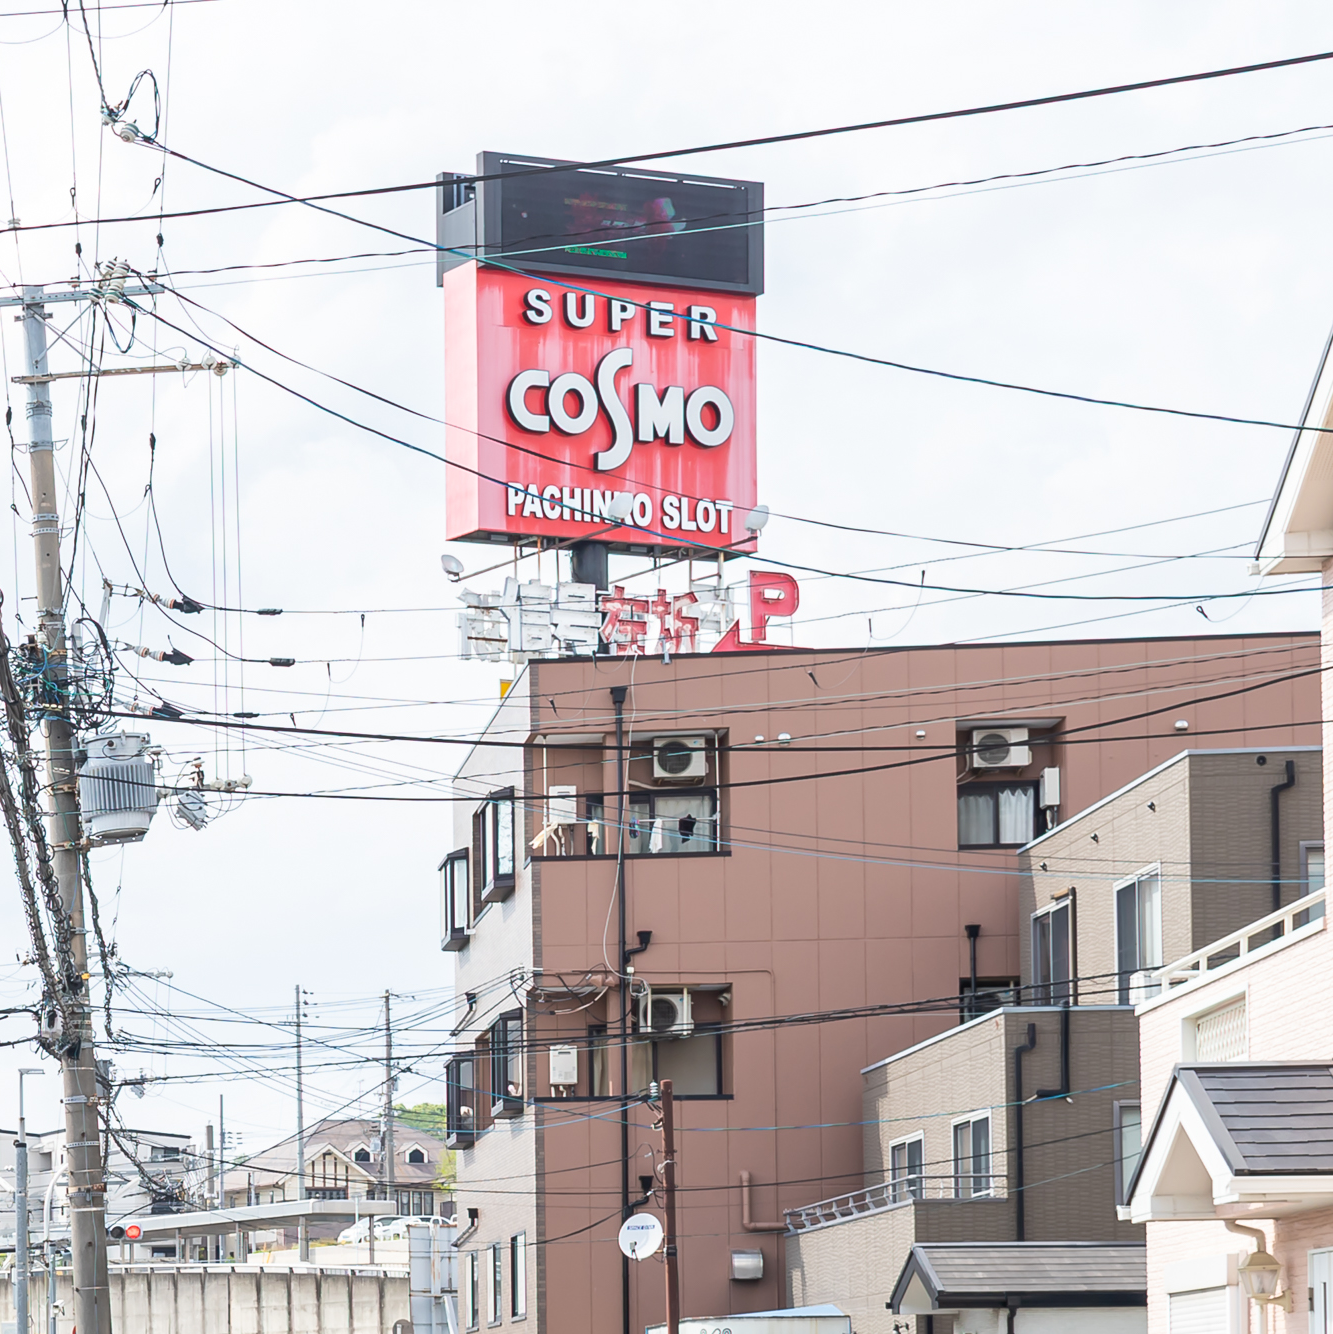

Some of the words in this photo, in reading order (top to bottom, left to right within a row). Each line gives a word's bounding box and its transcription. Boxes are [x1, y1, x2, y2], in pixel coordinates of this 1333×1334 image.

[523, 287, 718, 343] SUPER
[507, 346, 735, 472] COSMO
[661, 496, 734, 534] SLOT
[747, 570, 800, 642] P
